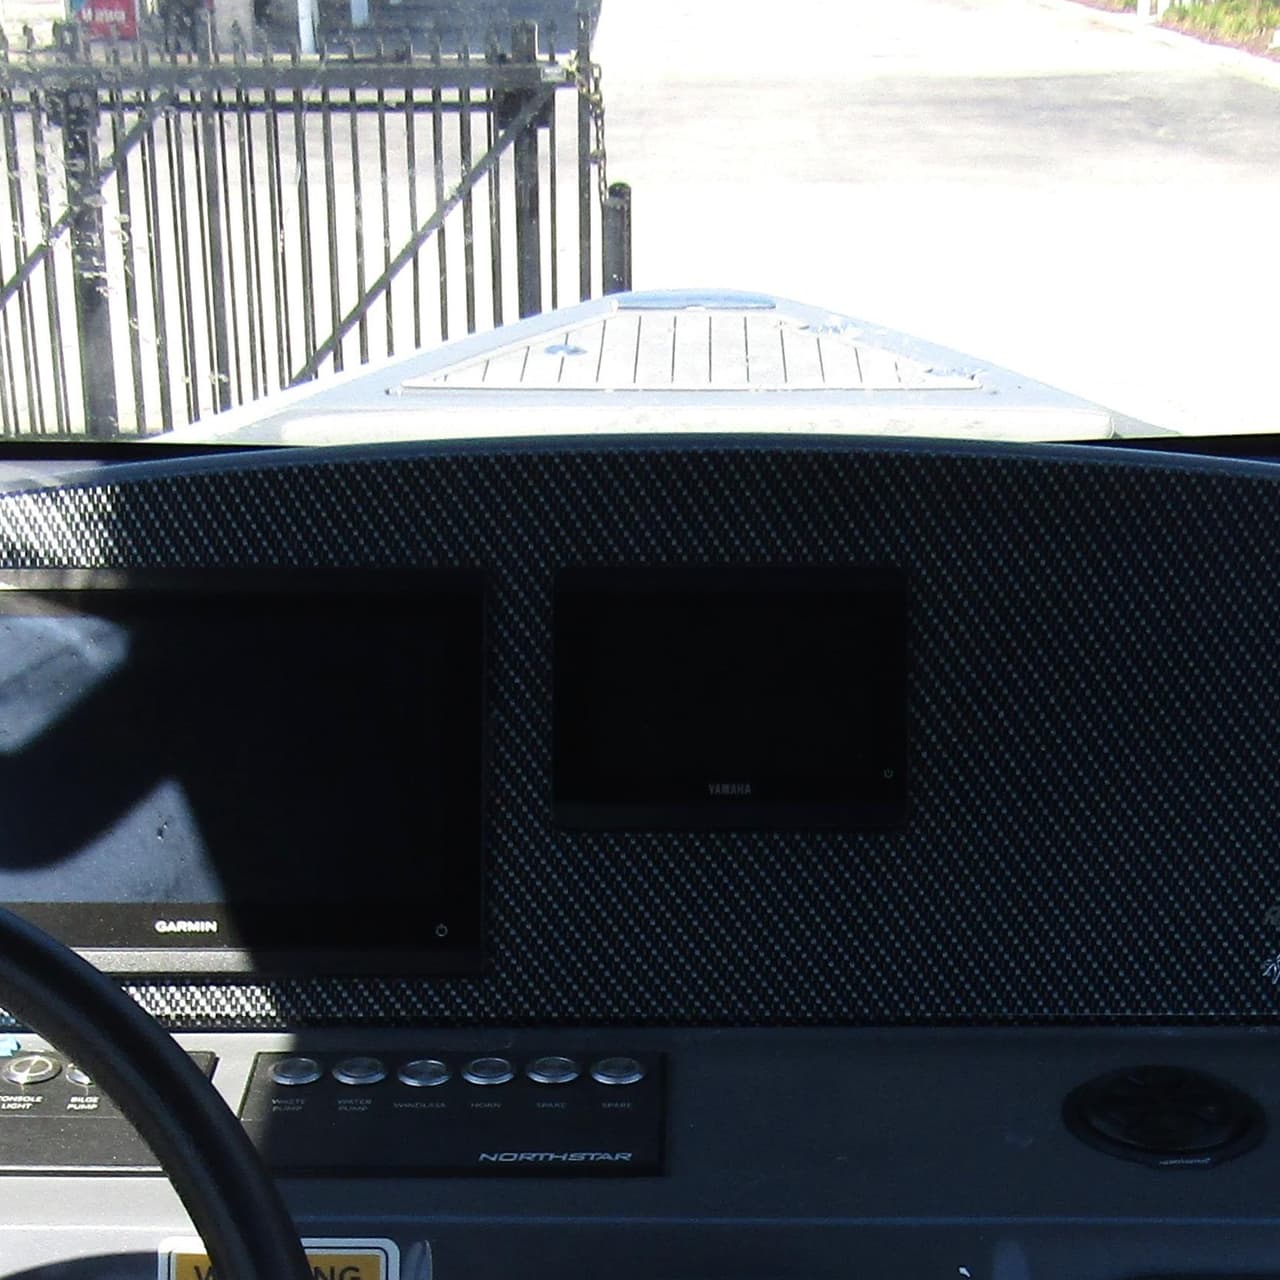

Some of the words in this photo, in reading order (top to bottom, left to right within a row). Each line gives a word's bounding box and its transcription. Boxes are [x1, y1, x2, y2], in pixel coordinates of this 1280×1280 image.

[708, 783, 751, 795] YAMAHA
[155, 920, 218, 932] GARMIN
[1, 1102, 33, 1110] LIGHT
[478, 1152, 633, 1163] NORTHSTAR
